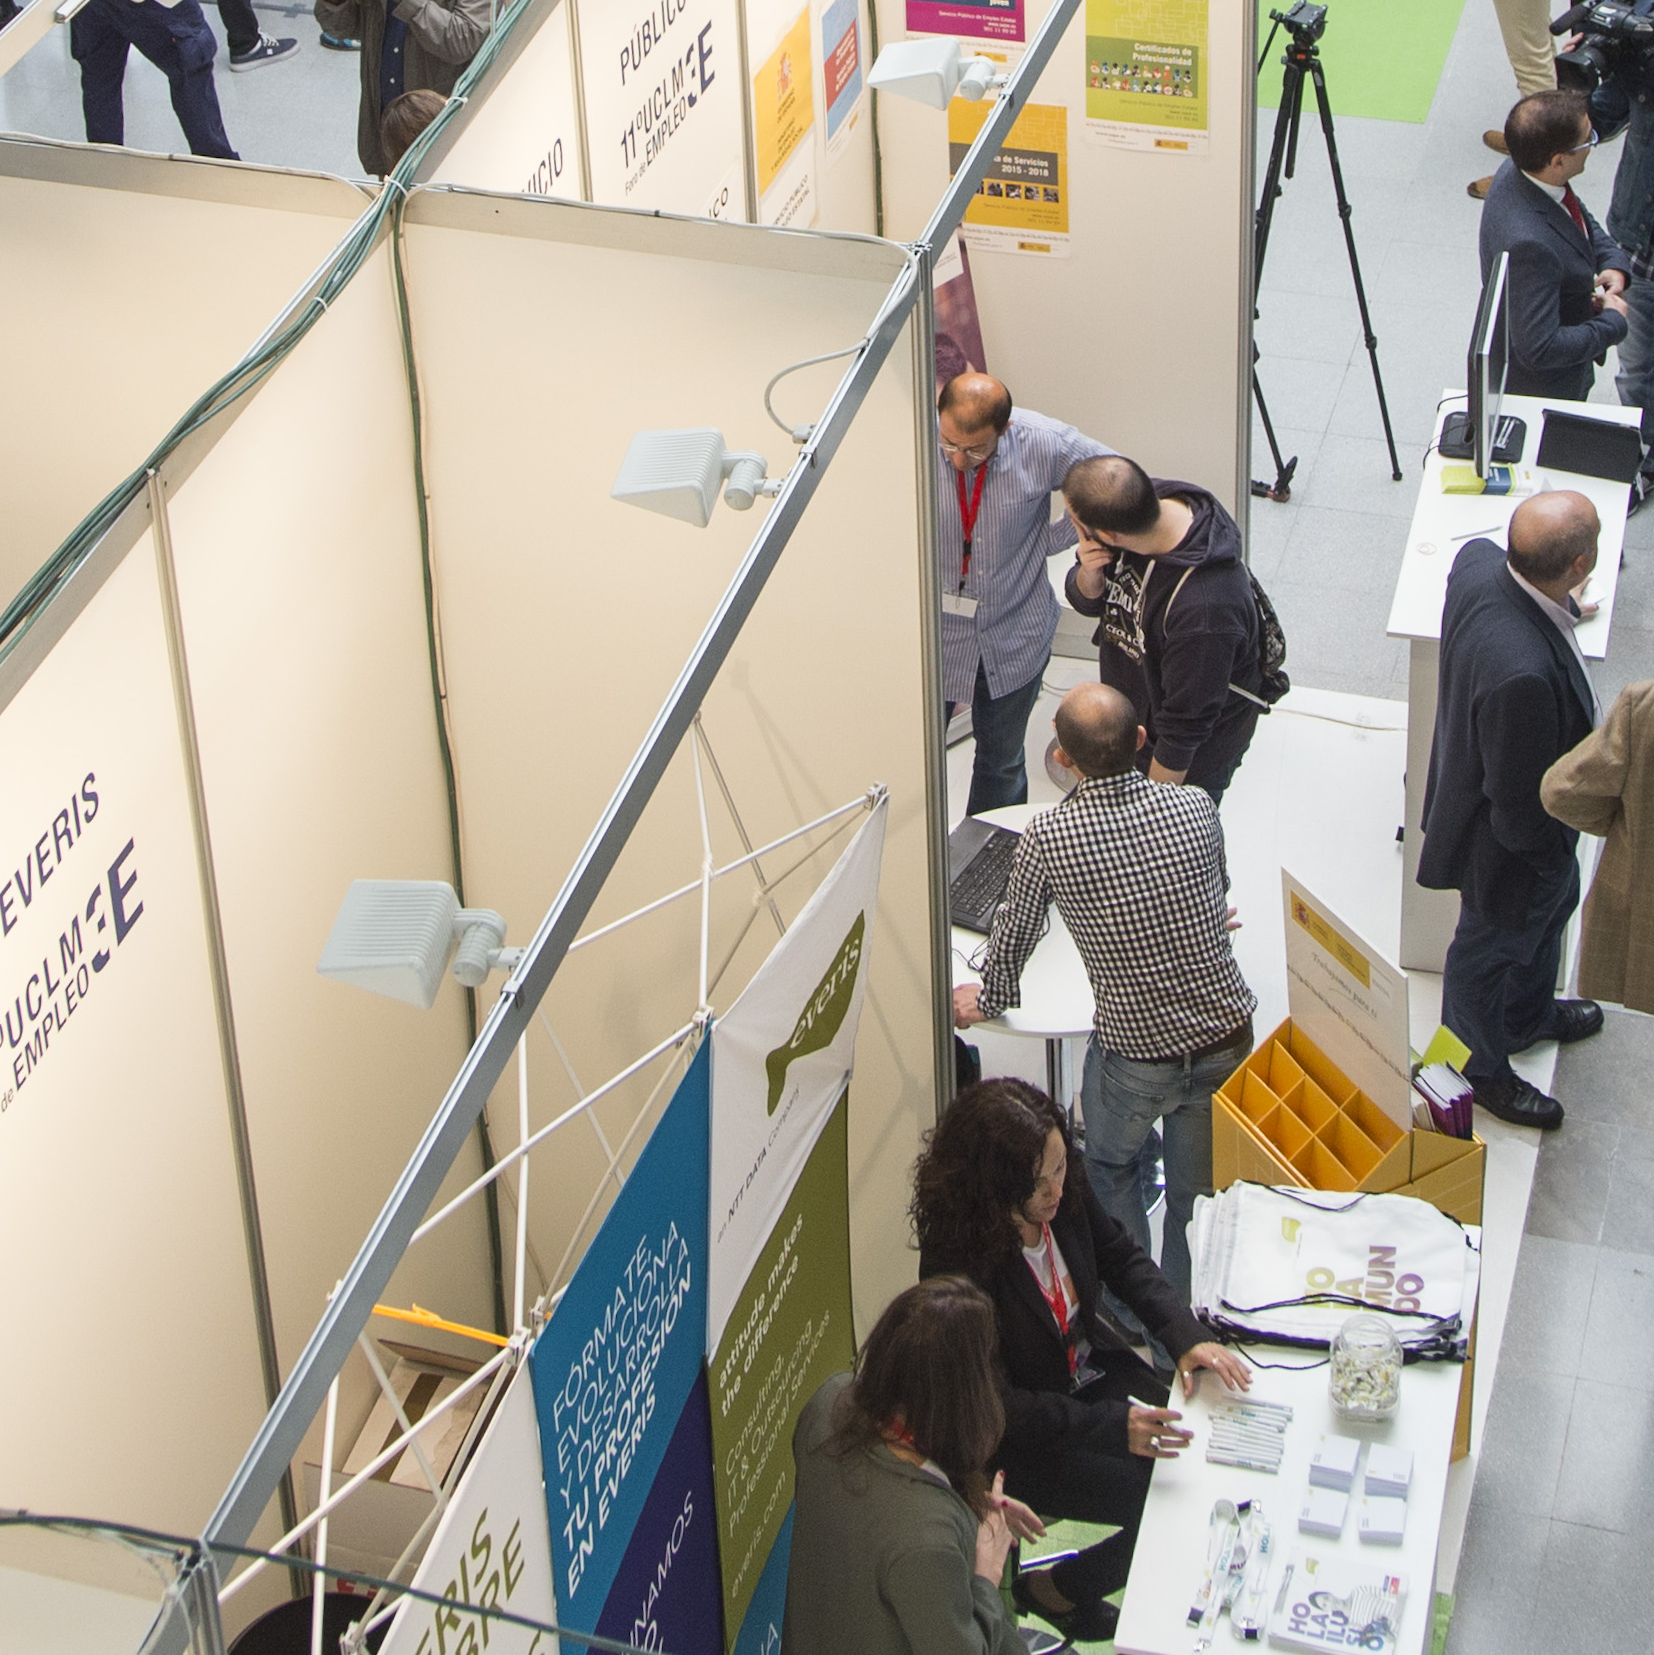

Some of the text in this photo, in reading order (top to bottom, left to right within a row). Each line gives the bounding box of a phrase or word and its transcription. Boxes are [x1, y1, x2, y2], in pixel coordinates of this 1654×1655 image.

[1133, 53, 1192, 66] Profesionalidad
[1134, 43, 1192, 56] Certificados de
[625, 174, 639, 197] Foro
[646, 96, 687, 167] EMPLEO
[1001, 164, 1022, 174] 2015
[1028, 167, 1049, 177] 2018
[1003, 155, 1049, 167] de Servicios
[1, 1087, 15, 1113] de
[13, 962, 90, 1093] EMPLEO
[790, 937, 861, 1049] everis
[1312, 951, 1351, 995] Trabajamos
[1352, 991, 1370, 1013] para
[727, 1185, 745, 1223] NTT
[745, 1146, 767, 1190] DATA
[768, 1082, 800, 1148] Company
[556, 1220, 679, 1475] EVOLUCIONA
[718, 1213, 803, 1390] attitude makes
[721, 1254, 800, 1418] the difference
[560, 1237, 688, 1510] Y DESARROLLA
[562, 1260, 692, 1552] TU PROFESIÓN
[725, 1353, 785, 1476] Consulting,
[727, 1475, 738, 1508] IT
[750, 1317, 813, 1452] Outsourcing
[728, 1309, 831, 1538] Professional Services
[567, 1380, 657, 1600] EN EVERIS
[731, 1470, 786, 1598] everis.com
[1288, 1602, 1311, 1635] HO
[1307, 1612, 1331, 1640] LA
[1326, 1610, 1349, 1645] ILU
